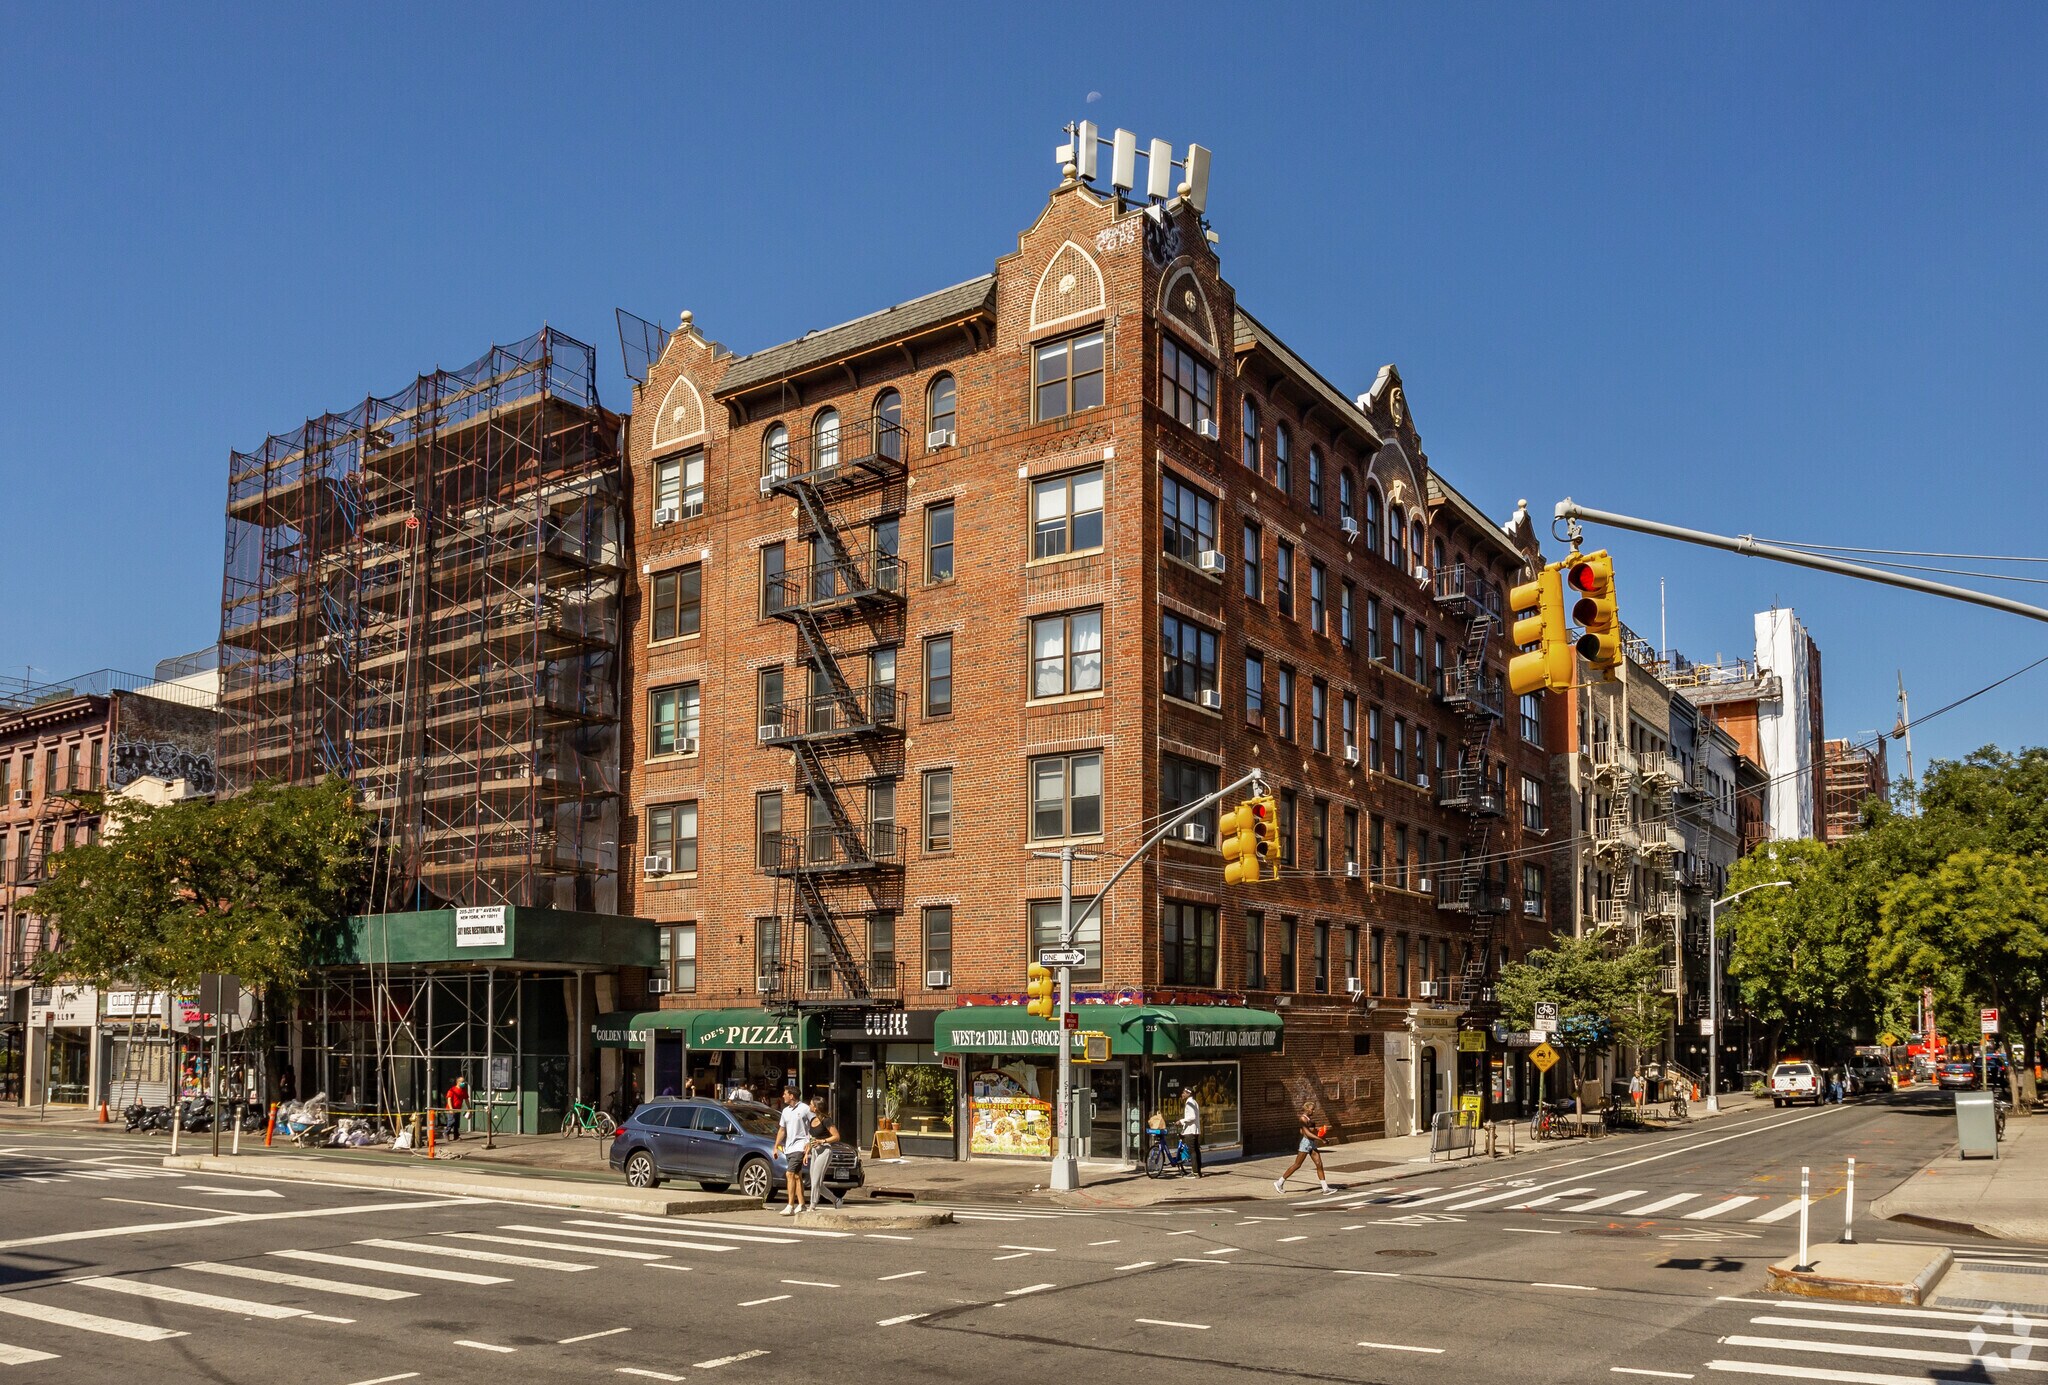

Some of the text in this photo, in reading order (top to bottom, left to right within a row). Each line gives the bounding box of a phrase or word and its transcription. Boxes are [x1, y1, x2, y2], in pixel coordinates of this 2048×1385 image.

[1097, 231, 1135, 251] COPS
[1064, 953, 1080, 961] WAY
[865, 1013, 908, 1036] COFFEE
[596, 1029, 621, 1042] GOLDEN
[622, 1030, 638, 1042] WOK
[700, 1026, 794, 1045] JOE'S PIZZA
[952, 1030, 975, 1047] WEST
[975, 1031, 986, 1046] 21
[988, 1030, 1008, 1046] DELI
[1011, 1030, 1029, 1046] AND
[1031, 1030, 1060, 1047] GROCE
[1189, 1030, 1276, 1047] WEST 21 DELI AND GROCERY CORP
[943, 1055, 960, 1068] ATM
